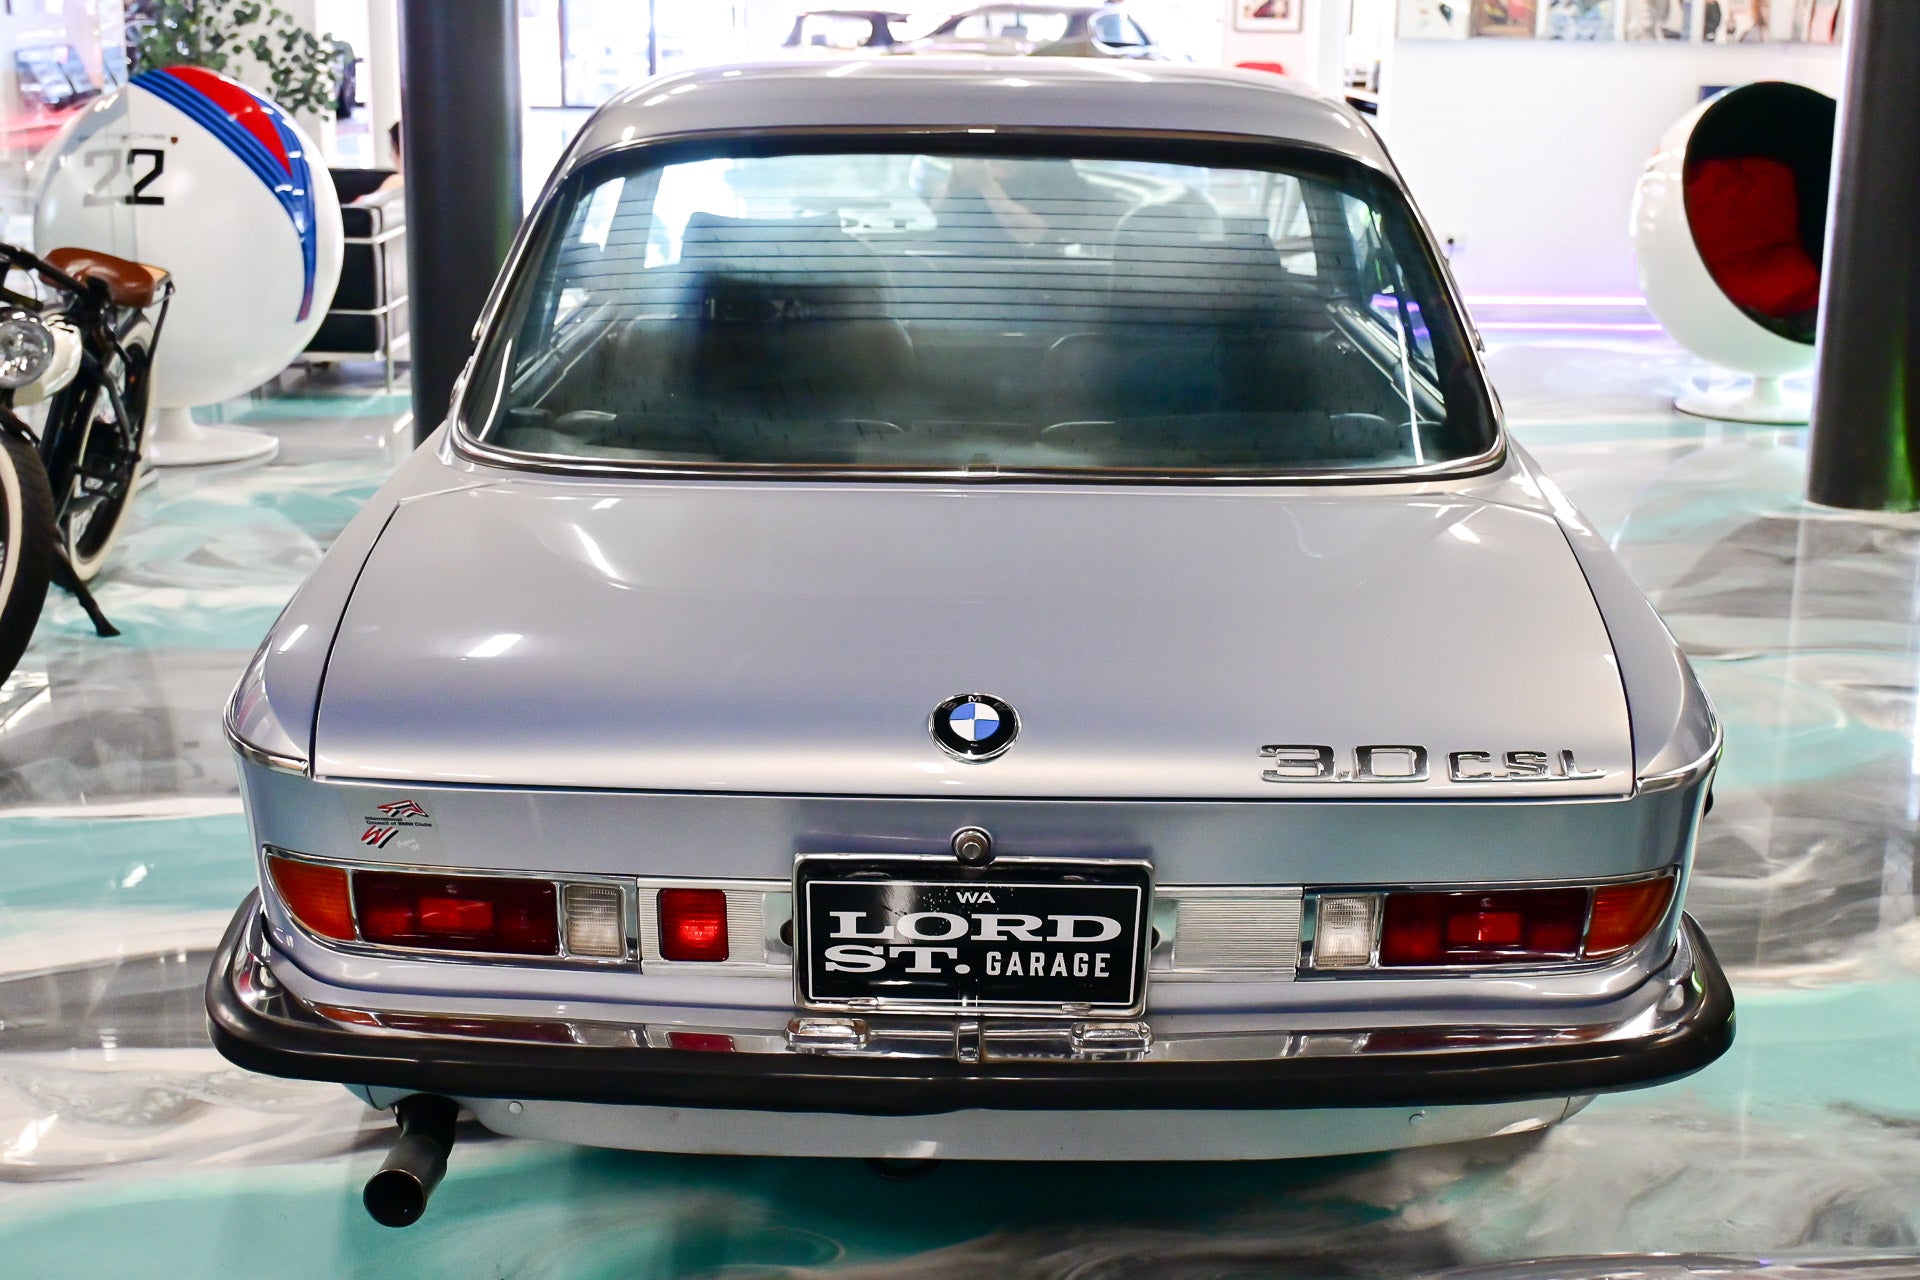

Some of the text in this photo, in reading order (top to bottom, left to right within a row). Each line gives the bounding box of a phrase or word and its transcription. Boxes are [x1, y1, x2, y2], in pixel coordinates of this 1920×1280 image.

[83, 148, 164, 205] 22
[1259, 744, 1607, 783] 3.0 CSL
[956, 891, 996, 904] WA
[829, 911, 1122, 942] LORD
[824, 945, 1111, 978] ST. GARAGE
